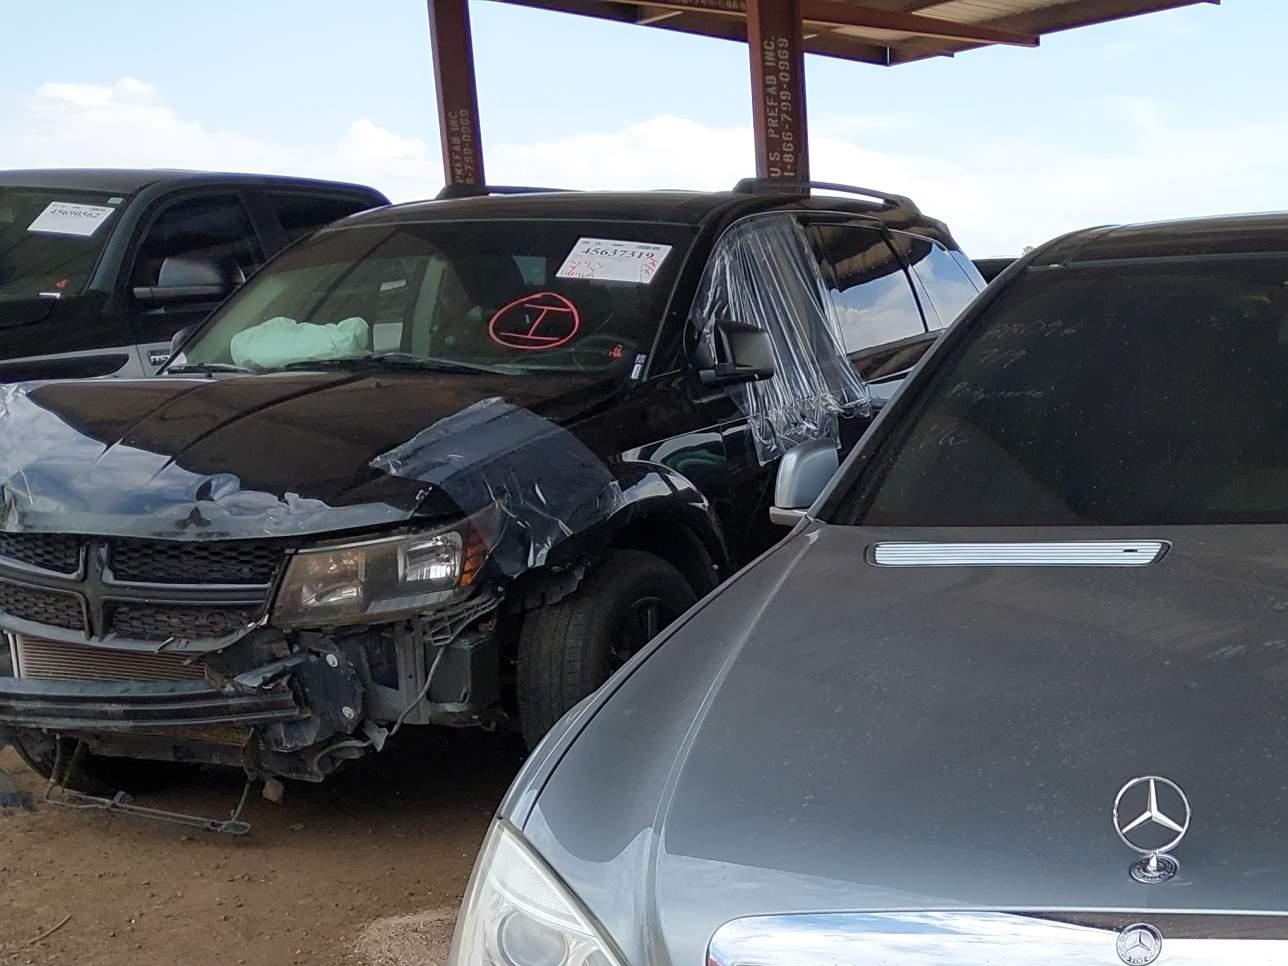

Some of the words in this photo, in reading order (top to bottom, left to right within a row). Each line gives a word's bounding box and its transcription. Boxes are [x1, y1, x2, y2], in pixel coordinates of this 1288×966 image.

[764, 75, 780, 138] PREFAB
[777, 37, 796, 177] 1-866-799-0969
[582, 247, 655, 259] 45637319
